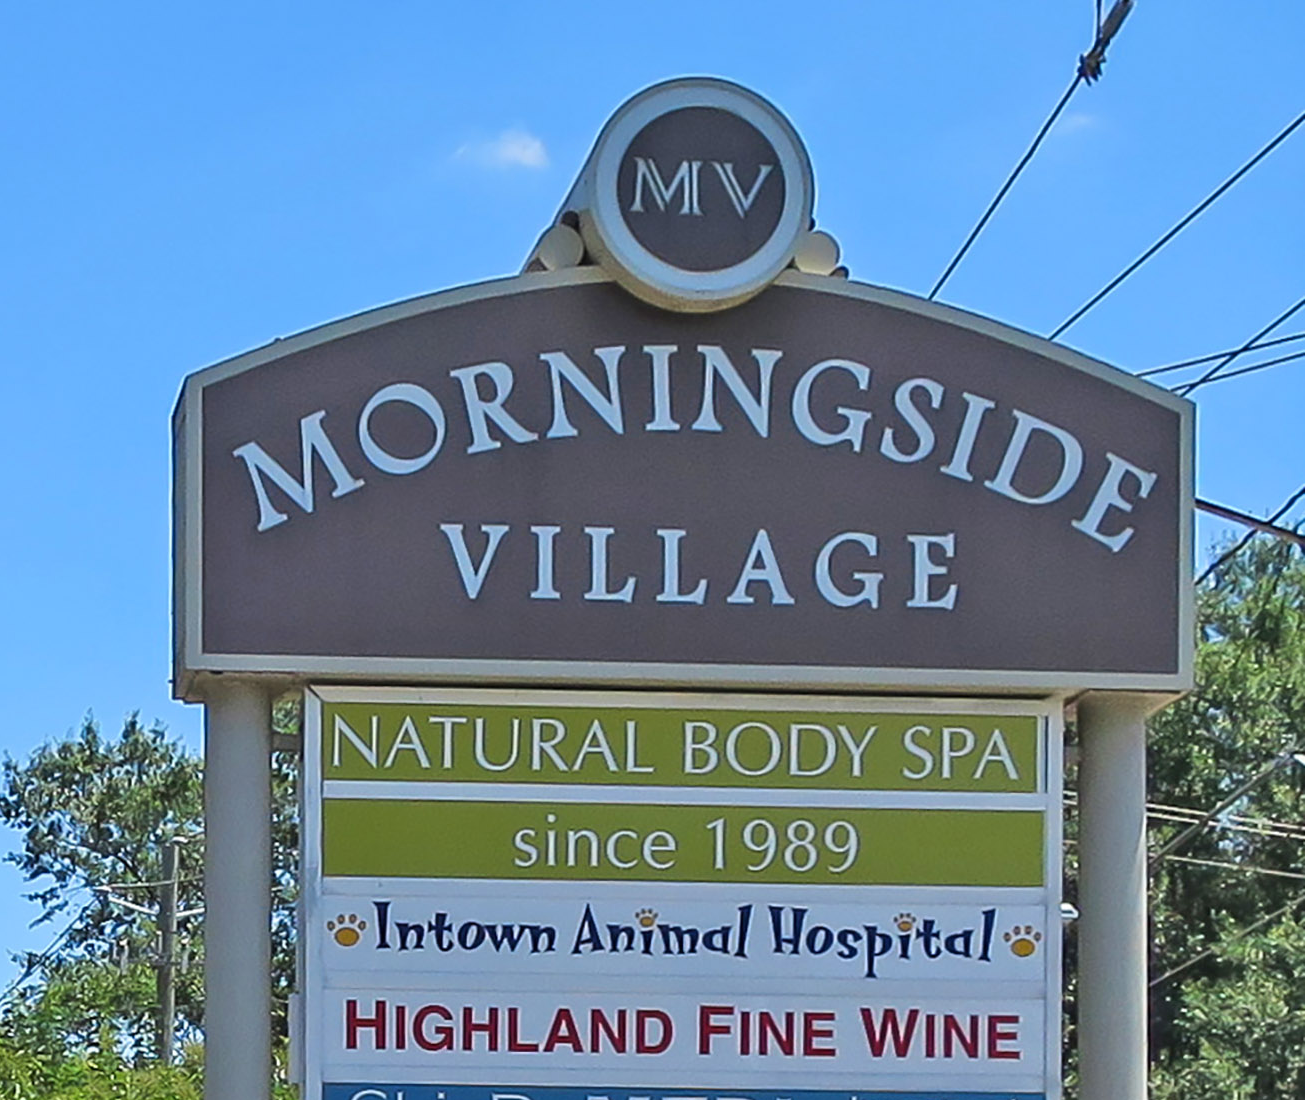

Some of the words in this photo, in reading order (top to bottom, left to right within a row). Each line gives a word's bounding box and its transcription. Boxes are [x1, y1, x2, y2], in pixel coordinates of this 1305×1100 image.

[628, 155, 774, 217] MV
[233, 344, 1157, 553] MORNINGSIDE
[439, 523, 958, 610] VILLAGE
[332, 714, 655, 773] NATURAL
[683, 721, 877, 777] BODY
[902, 725, 1019, 780] SPA
[513, 814, 676, 869] since
[706, 818, 859, 872] 1989
[372, 900, 556, 954] Intown
[571, 903, 753, 959] Animal
[768, 905, 996, 979] Hospital
[345, 999, 675, 1055] HIGHLAND
[698, 1004, 837, 1058] FINE
[859, 1007, 1021, 1060] WINE
